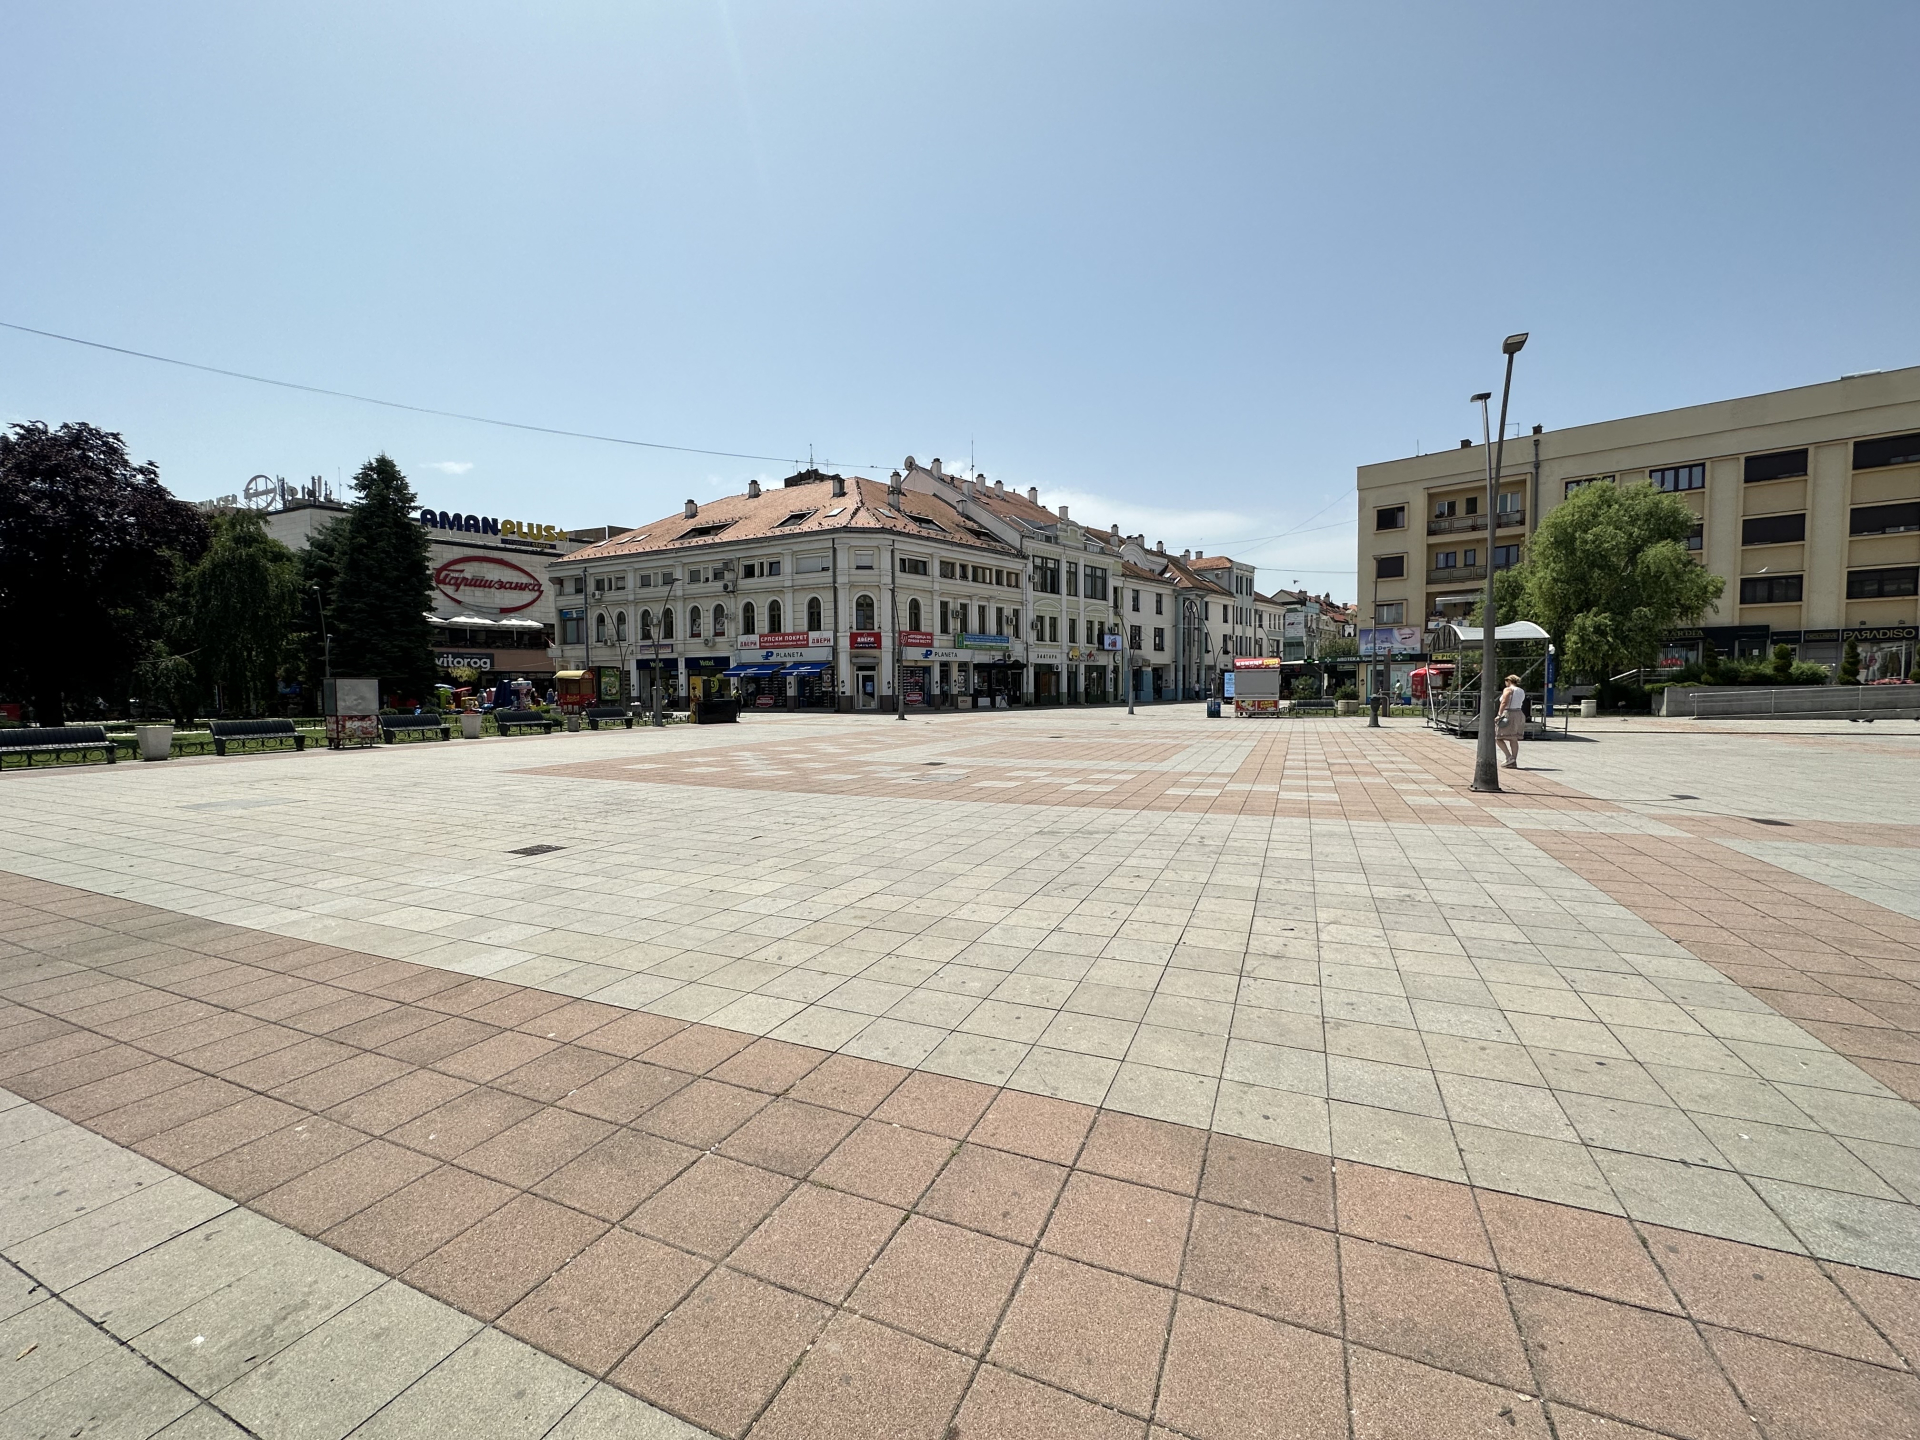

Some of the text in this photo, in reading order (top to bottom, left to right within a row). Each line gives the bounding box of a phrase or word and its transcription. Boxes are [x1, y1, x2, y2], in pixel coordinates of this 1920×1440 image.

[420, 508, 557, 542] AMAN PLUS
[434, 653, 491, 671] vitorog
